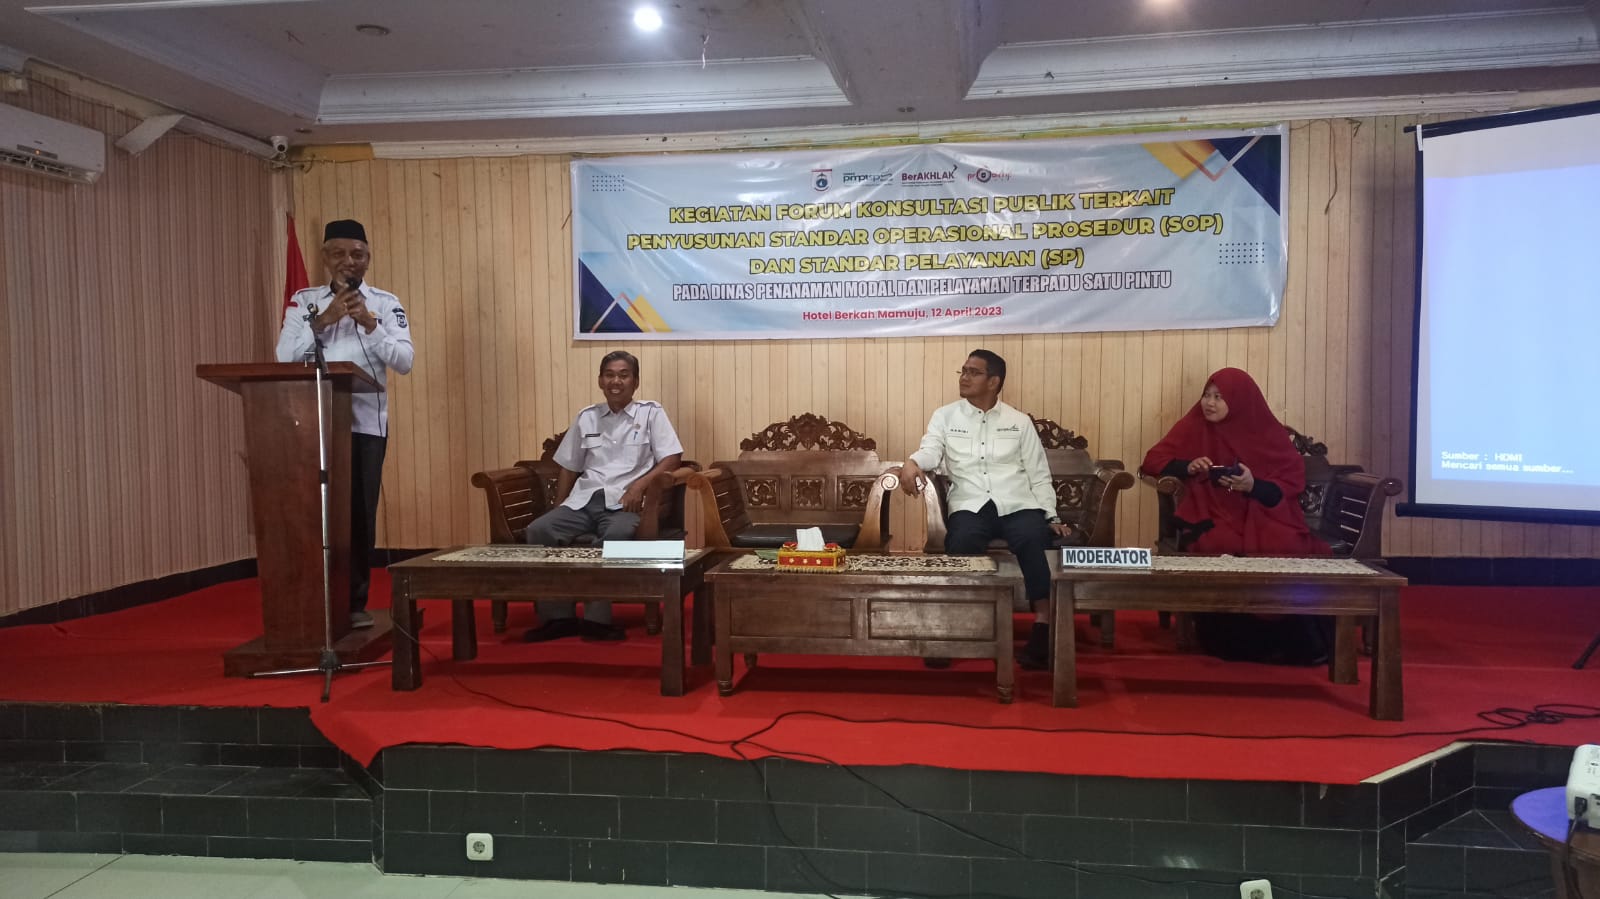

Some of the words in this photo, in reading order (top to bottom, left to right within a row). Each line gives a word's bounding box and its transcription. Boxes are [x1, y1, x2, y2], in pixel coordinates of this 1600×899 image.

[901, 171, 955, 181] BerAKHLAK
[669, 206, 771, 223] KEGIATAN
[776, 202, 852, 220] FORUM
[856, 197, 988, 217] KONSULTASI
[993, 192, 1075, 213] PUBLIK
[1079, 187, 1175, 209] TERKAIT
[627, 232, 766, 250] PENYUSUNAN
[769, 227, 868, 247] STANDAR
[872, 222, 1027, 244] OPERASIONAL
[1033, 216, 1154, 239] PROSEDUR
[1159, 213, 1223, 237] (SOP)
[750, 259, 795, 274] DAN
[799, 254, 900, 273] STANDAR
[904, 249, 1036, 271] PELAYANAN
[1041, 247, 1084, 268] (SP)
[672, 284, 709, 301] PADA
[710, 284, 753, 300] DINAS
[755, 282, 842, 299] PENANAMAN
[844, 280, 896, 298] MODAL
[897, 278, 928, 296] DAN
[929, 276, 1011, 295] PELAYANAN
[1012, 274, 1081, 293] TERPADU
[1082, 272, 1124, 290] SATU
[1124, 270, 1172, 289] PINTU
[802, 311, 832, 321] Hotel
[835, 310, 875, 321] Berkah
[878, 308, 928, 322] Mamuju,
[931, 309, 942, 318] 12
[945, 307, 972, 320] April
[974, 306, 1002, 317] 2023
[1441, 451, 1480, 461] Sumber
[1494, 453, 1523, 462] HDMI
[1441, 460, 1482, 470] Mencari
[1485, 464, 1519, 472] semua
[1066, 550, 1148, 564] MODERATOR
